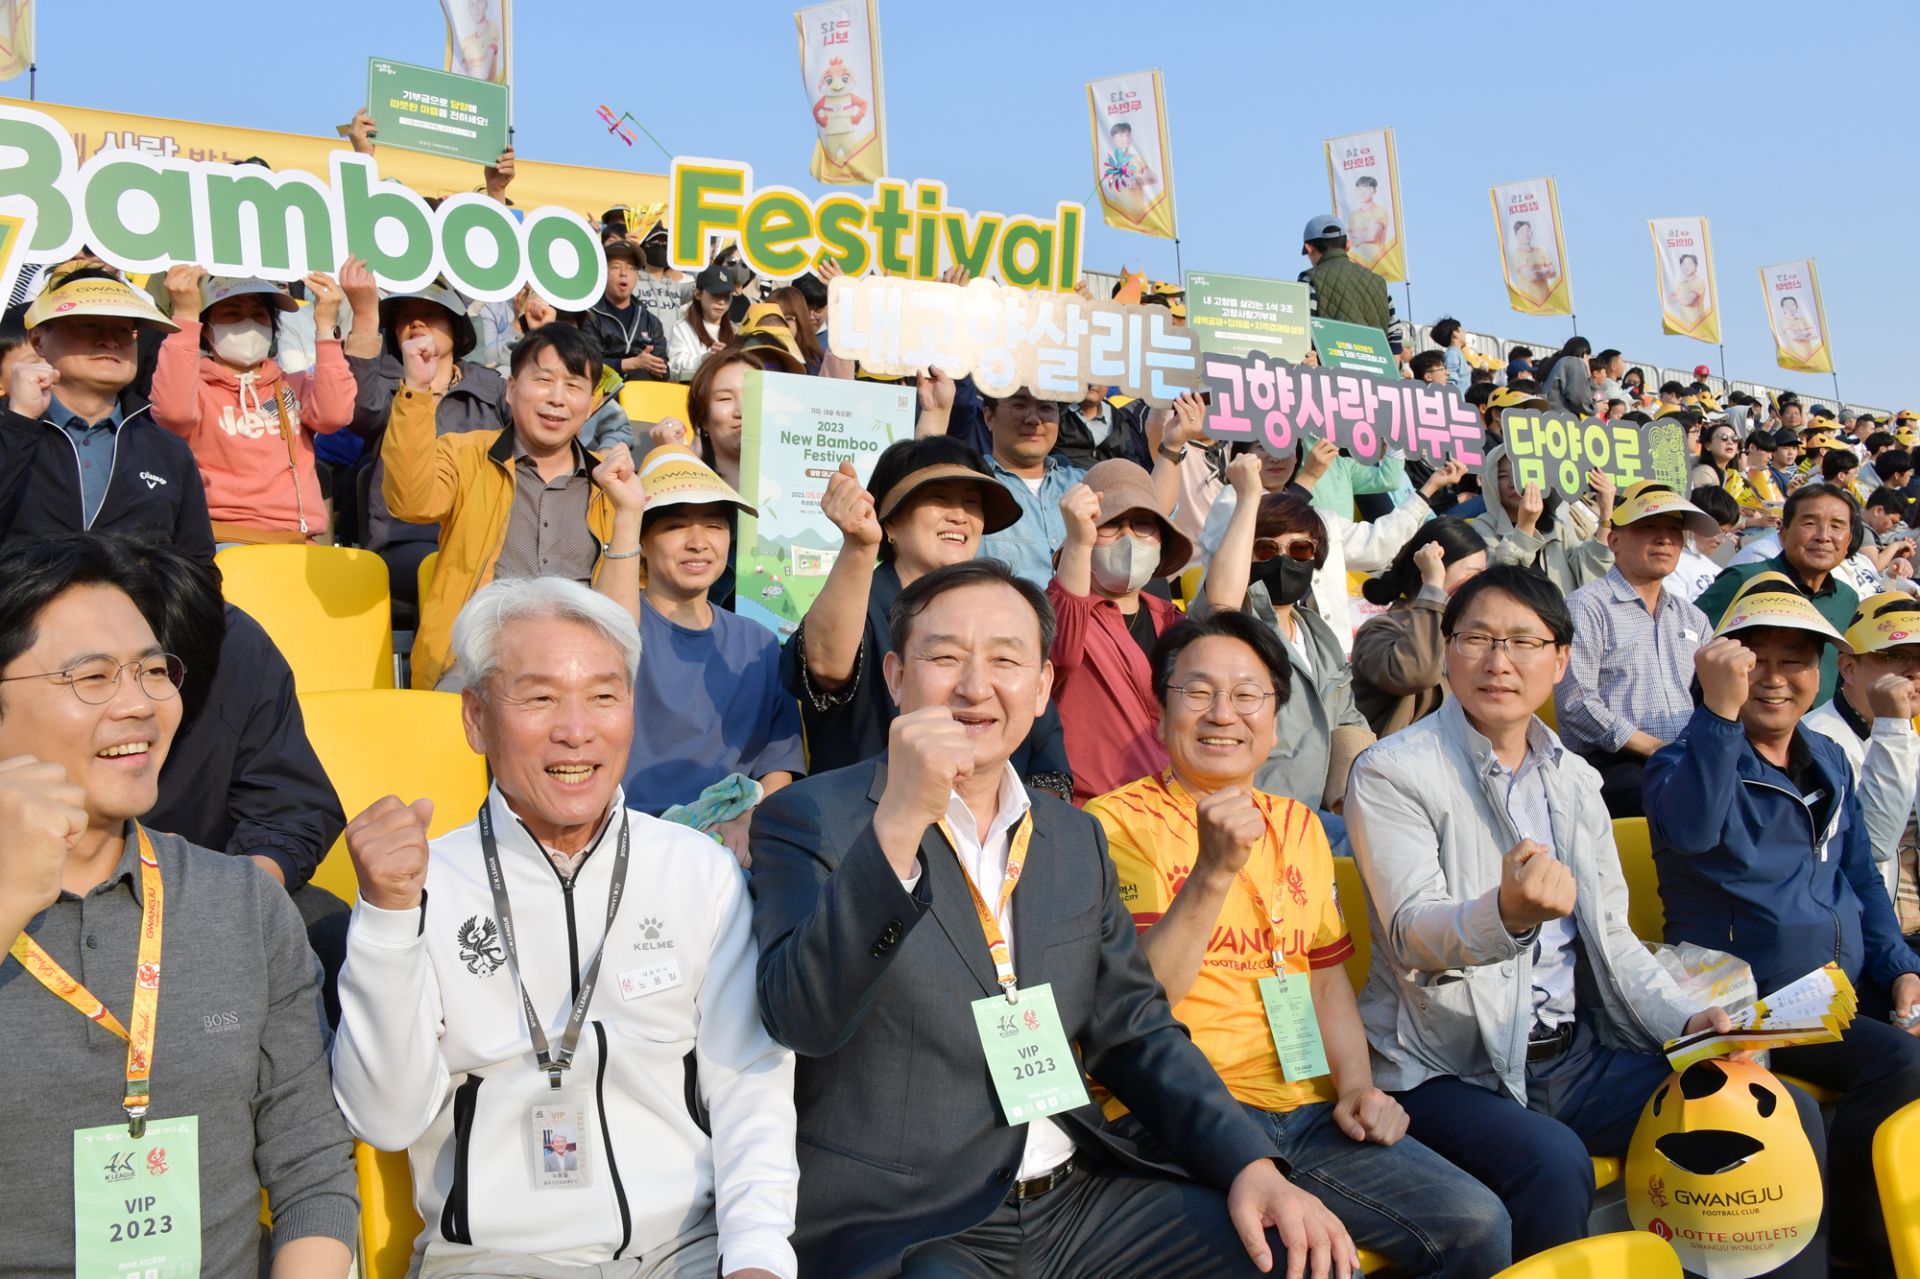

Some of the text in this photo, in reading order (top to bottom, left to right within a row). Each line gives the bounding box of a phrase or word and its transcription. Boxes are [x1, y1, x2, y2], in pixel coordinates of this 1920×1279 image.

[402, 90, 448, 107] 기부금으로
[0, 118, 599, 300] Bamboo
[674, 164, 1084, 293] Festival
[1203, 296, 1212, 305] 내
[1206, 359, 1483, 466] 고향사랑기부는
[817, 421, 844, 433] 2023
[780, 431, 878, 452] New Bamboo
[804, 449, 855, 463] Festival
[1508, 416, 1645, 495] 담양으로
[1119, 884, 1138, 894] 역시
[146, 888, 156, 939] GWANGJU
[633, 940, 675, 951] KELME
[1202, 959, 1258, 971] FOOTBALL
[203, 1010, 239, 1028] BOSS
[1017, 1045, 1039, 1059] VIP
[1013, 1057, 1056, 1080] 2023
[111, 1171, 135, 1180] LEAGUE
[1675, 1185, 1783, 1207] GWANGJU
[125, 1196, 156, 1214] VIP
[110, 1215, 173, 1243] 2023
[1675, 1226, 1798, 1243] LOTTE OUTLETS
[1690, 1242, 1729, 1251] GWANGJU
